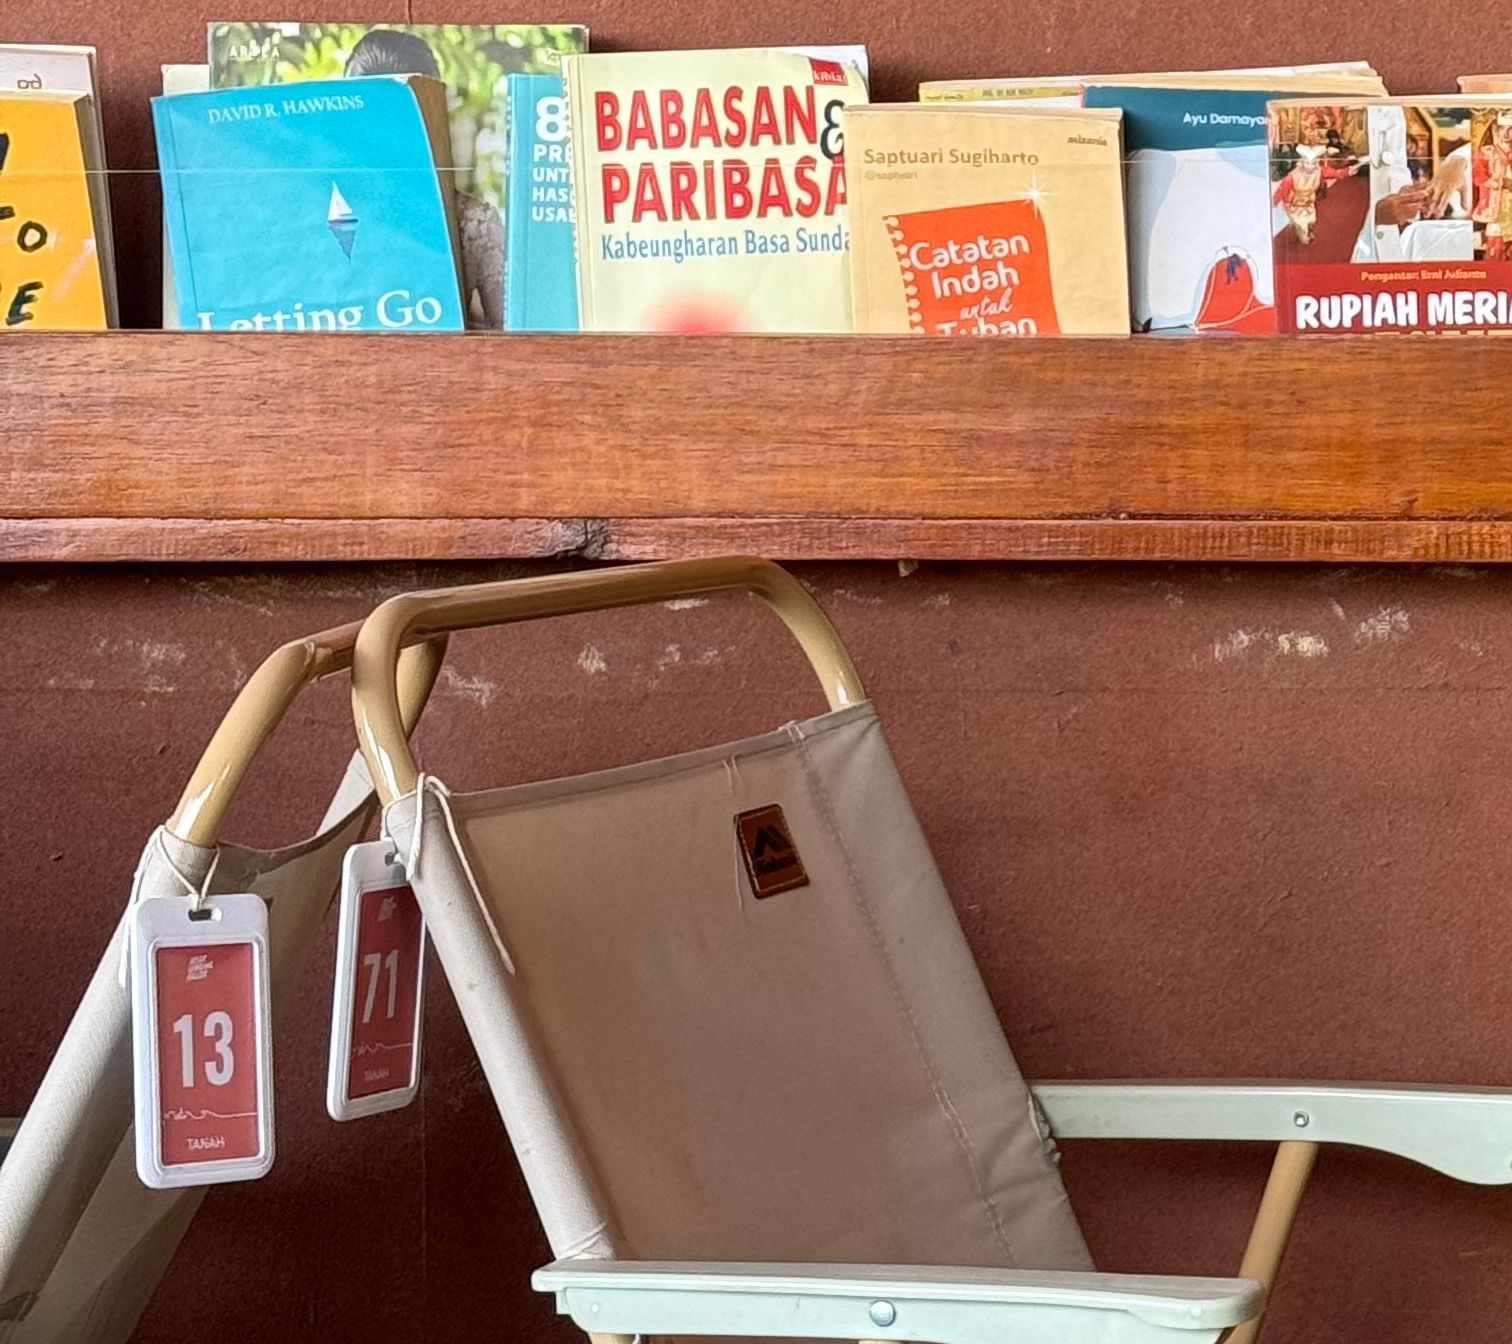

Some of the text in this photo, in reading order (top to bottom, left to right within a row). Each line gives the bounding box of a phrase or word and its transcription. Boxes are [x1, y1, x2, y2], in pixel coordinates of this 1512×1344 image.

[208, 105, 262, 124] DAVID
[283, 94, 365, 116] HAWKINS
[535, 96, 567, 142] 8
[595, 86, 817, 152] BABASAN
[1183, 112, 1208, 127] Ayu
[532, 167, 574, 183] UNT
[864, 148, 1040, 167] Saptuari Sugiharto
[601, 155, 848, 224] PARIBASA
[601, 229, 739, 263] Kabeungharan
[744, 229, 790, 255] Basa
[909, 234, 1031, 270] Catatan
[931, 260, 1020, 299] Indah
[376, 290, 442, 328] Go
[1296, 291, 1418, 330] RUPIAH
[362, 949, 399, 1024] 71
[172, 1011, 235, 1089] 13
